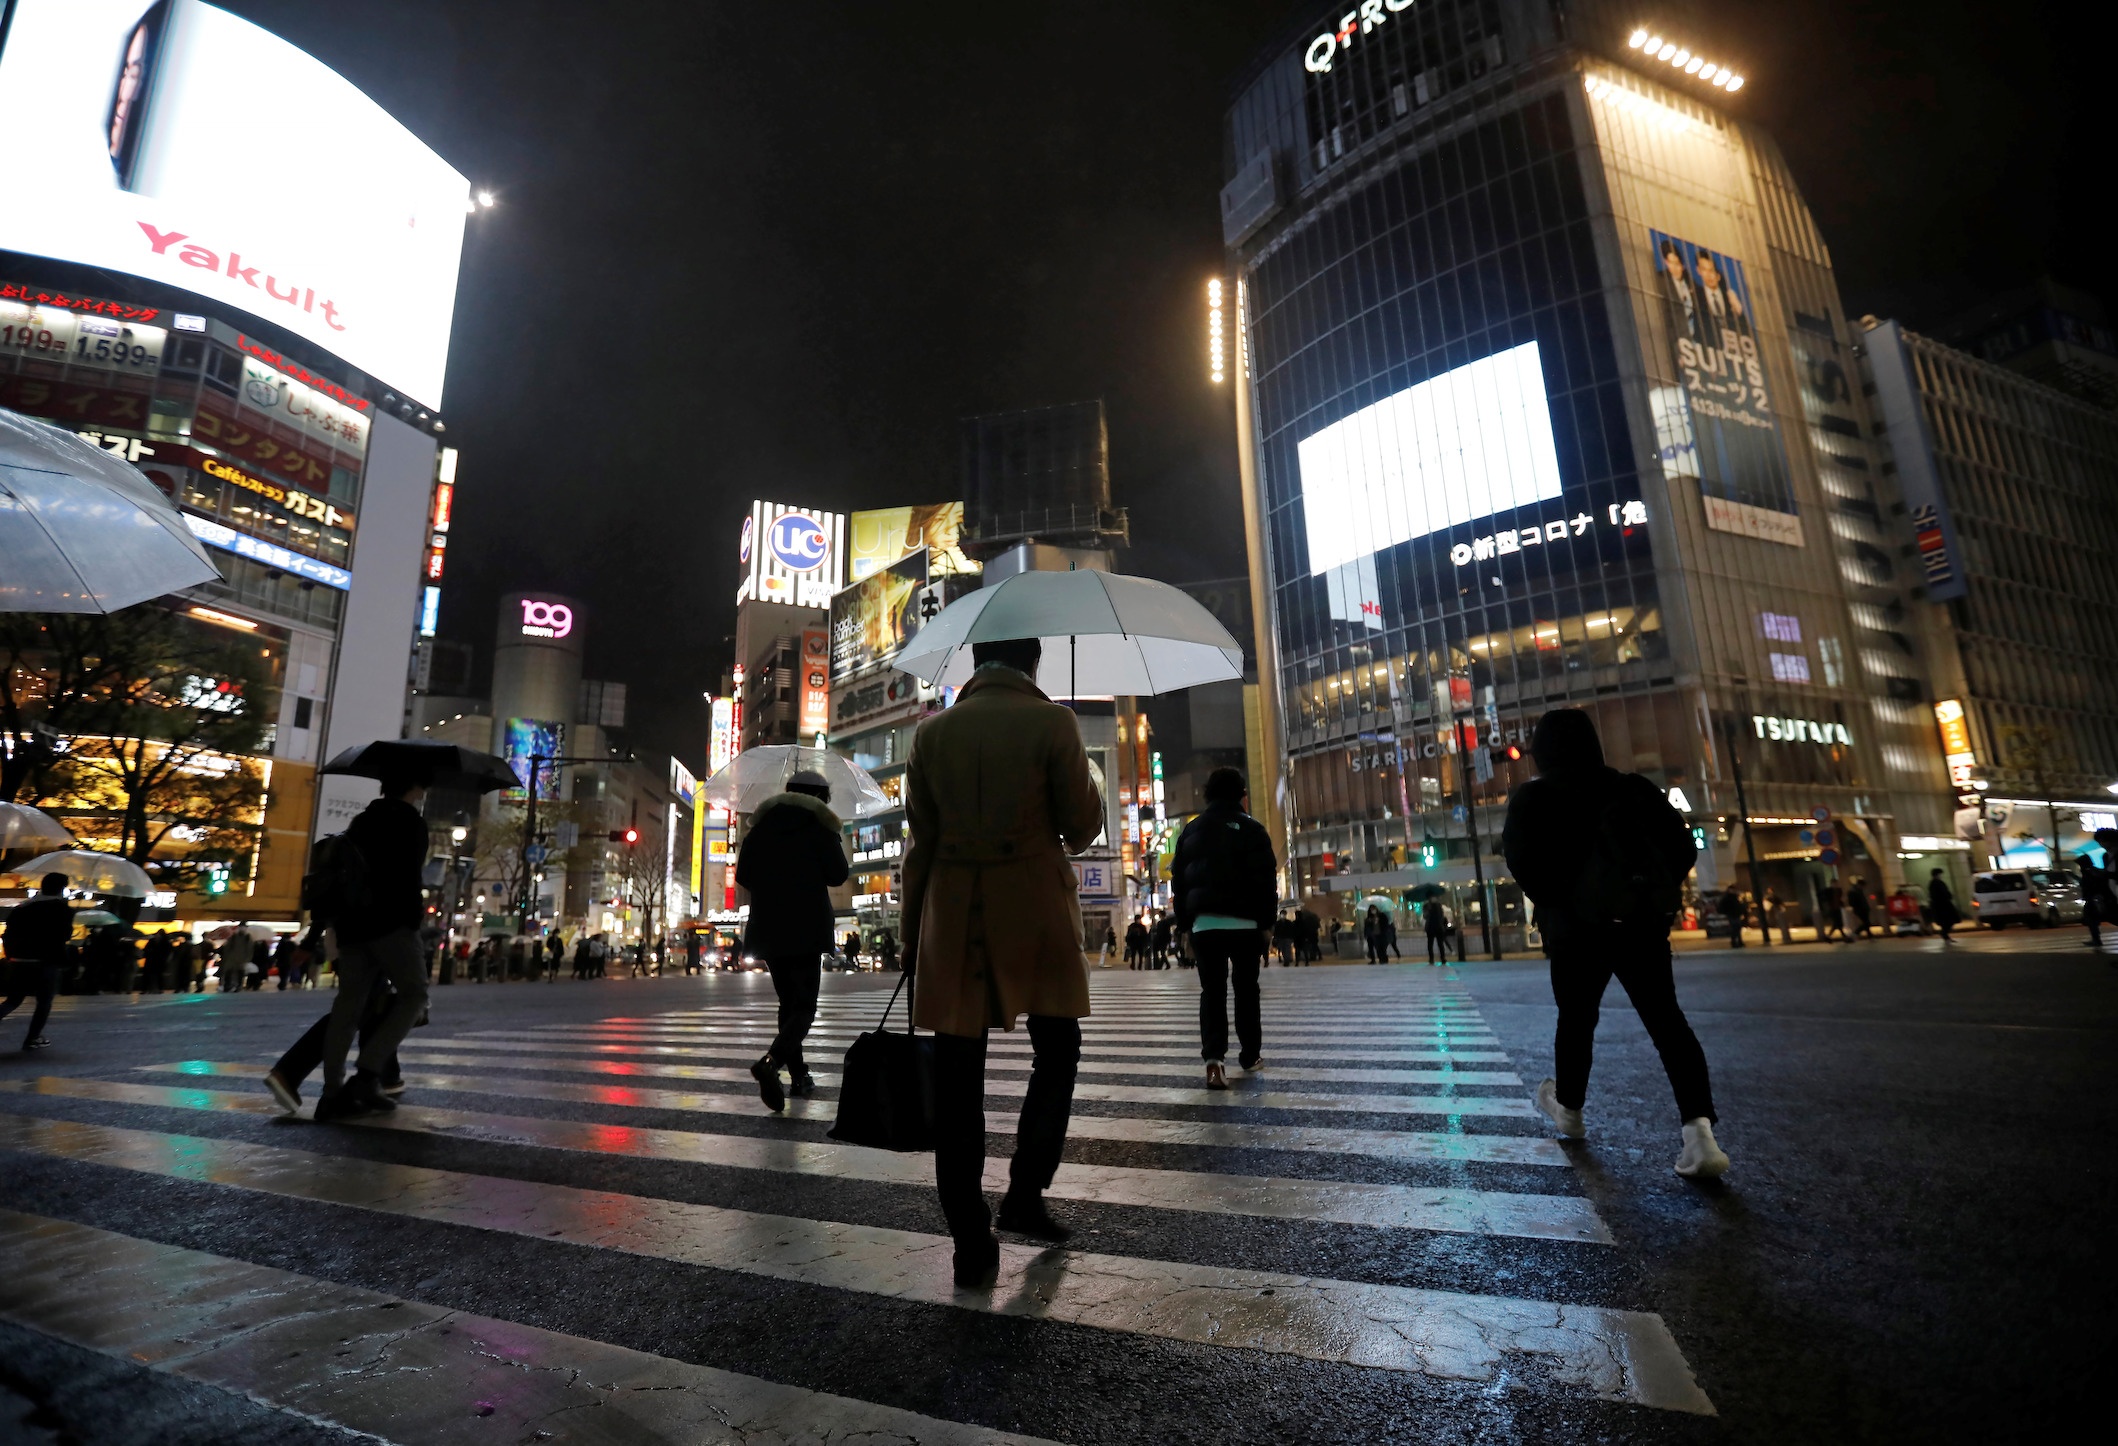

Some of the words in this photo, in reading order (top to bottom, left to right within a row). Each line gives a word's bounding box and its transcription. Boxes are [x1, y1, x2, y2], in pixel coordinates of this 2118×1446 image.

[137, 221, 347, 332] Yakult
[237, 334, 369, 410] しゃぶしゃぶバイキング
[1678, 337, 1763, 385] SUITS
[0, 378, 141, 419] ライス
[195, 411, 325, 481] コンタクト
[284, 489, 344, 527] ガスト
[854, 520, 923, 555] Uru
[1472, 512, 1594, 561] 新型コロナ
[1910, 503, 1954, 585] SEIBU
[236, 534, 348, 585] 英会話イーオン
[521, 599, 573, 638] 109
[833, 619, 865, 644] number
[834, 613, 853, 634] back
[1752, 715, 1854, 746] TSUTAYA
[1351, 742, 1456, 773] STARBUCK
[1084, 867, 1102, 887] 店
